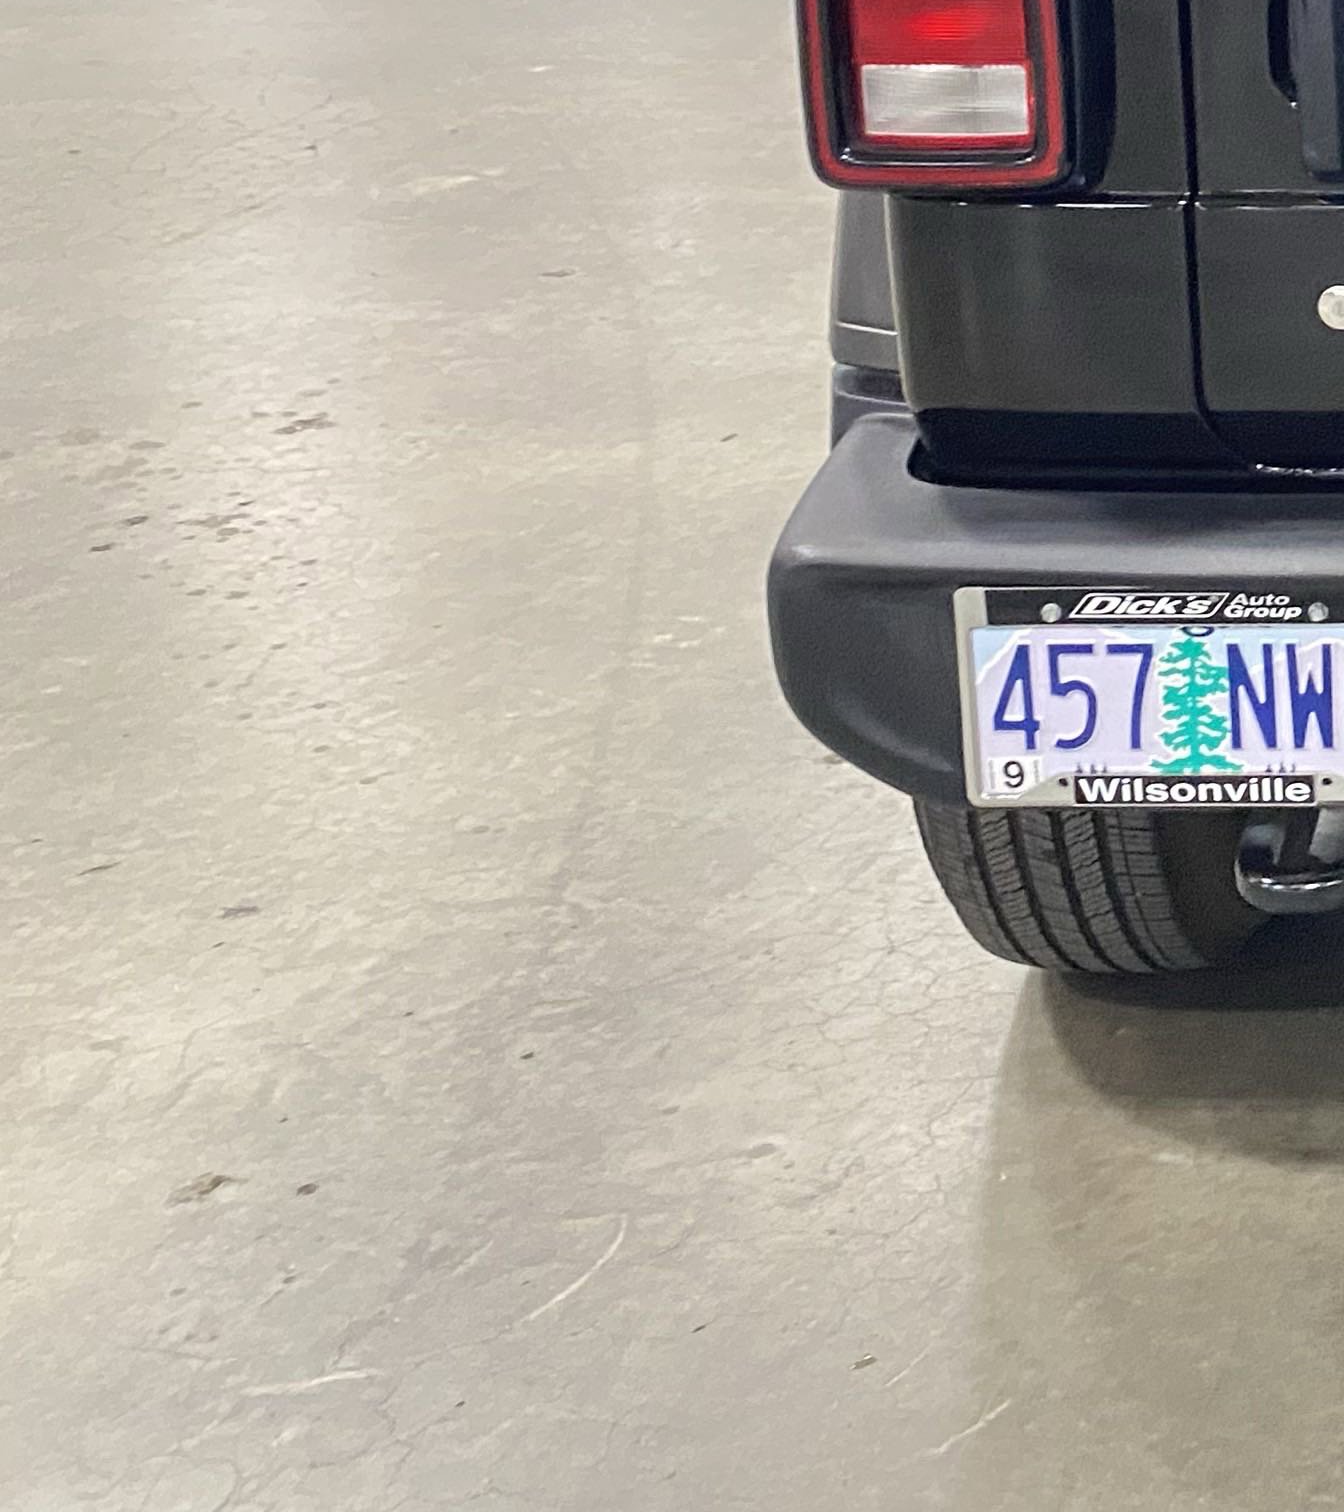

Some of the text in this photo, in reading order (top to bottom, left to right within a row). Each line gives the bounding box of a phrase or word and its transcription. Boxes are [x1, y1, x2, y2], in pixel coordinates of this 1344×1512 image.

[1080, 595, 1213, 615] Dick's
[1230, 593, 1290, 606] Auto
[1223, 605, 1303, 620] Group
[992, 643, 1155, 751] 457
[1003, 760, 1025, 788] 9
[1077, 776, 1312, 803] Wilsonville
